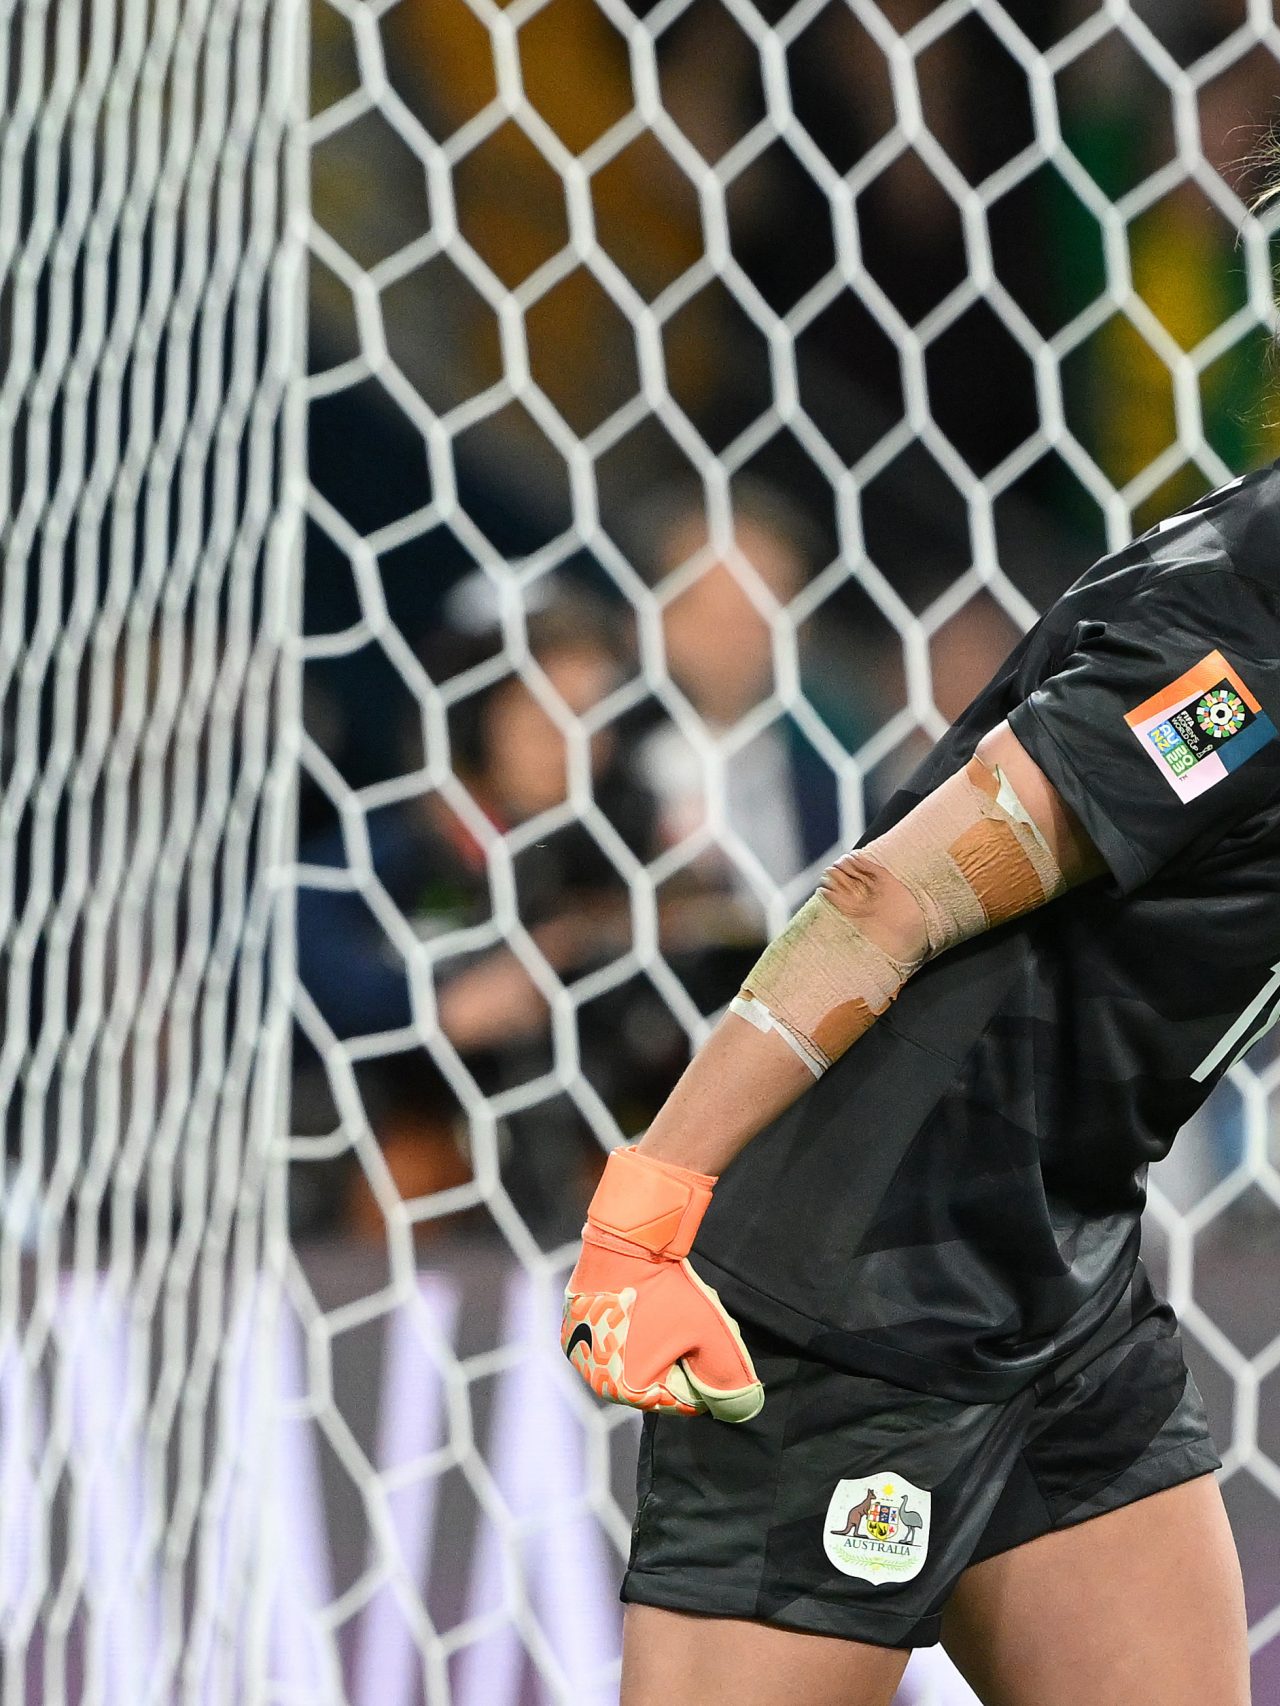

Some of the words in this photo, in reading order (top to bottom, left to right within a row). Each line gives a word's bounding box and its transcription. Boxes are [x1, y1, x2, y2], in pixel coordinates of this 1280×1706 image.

[1176, 714, 1200, 744] WOMEN'S
[1181, 710, 1194, 727] FIFA
[1151, 729, 1171, 752] NZ
[1159, 724, 1179, 745] AU
[1172, 717, 1190, 740] WORLD
[1187, 739, 1199, 751] CUP
[844, 1538, 911, 1555] AUSTRALIA
